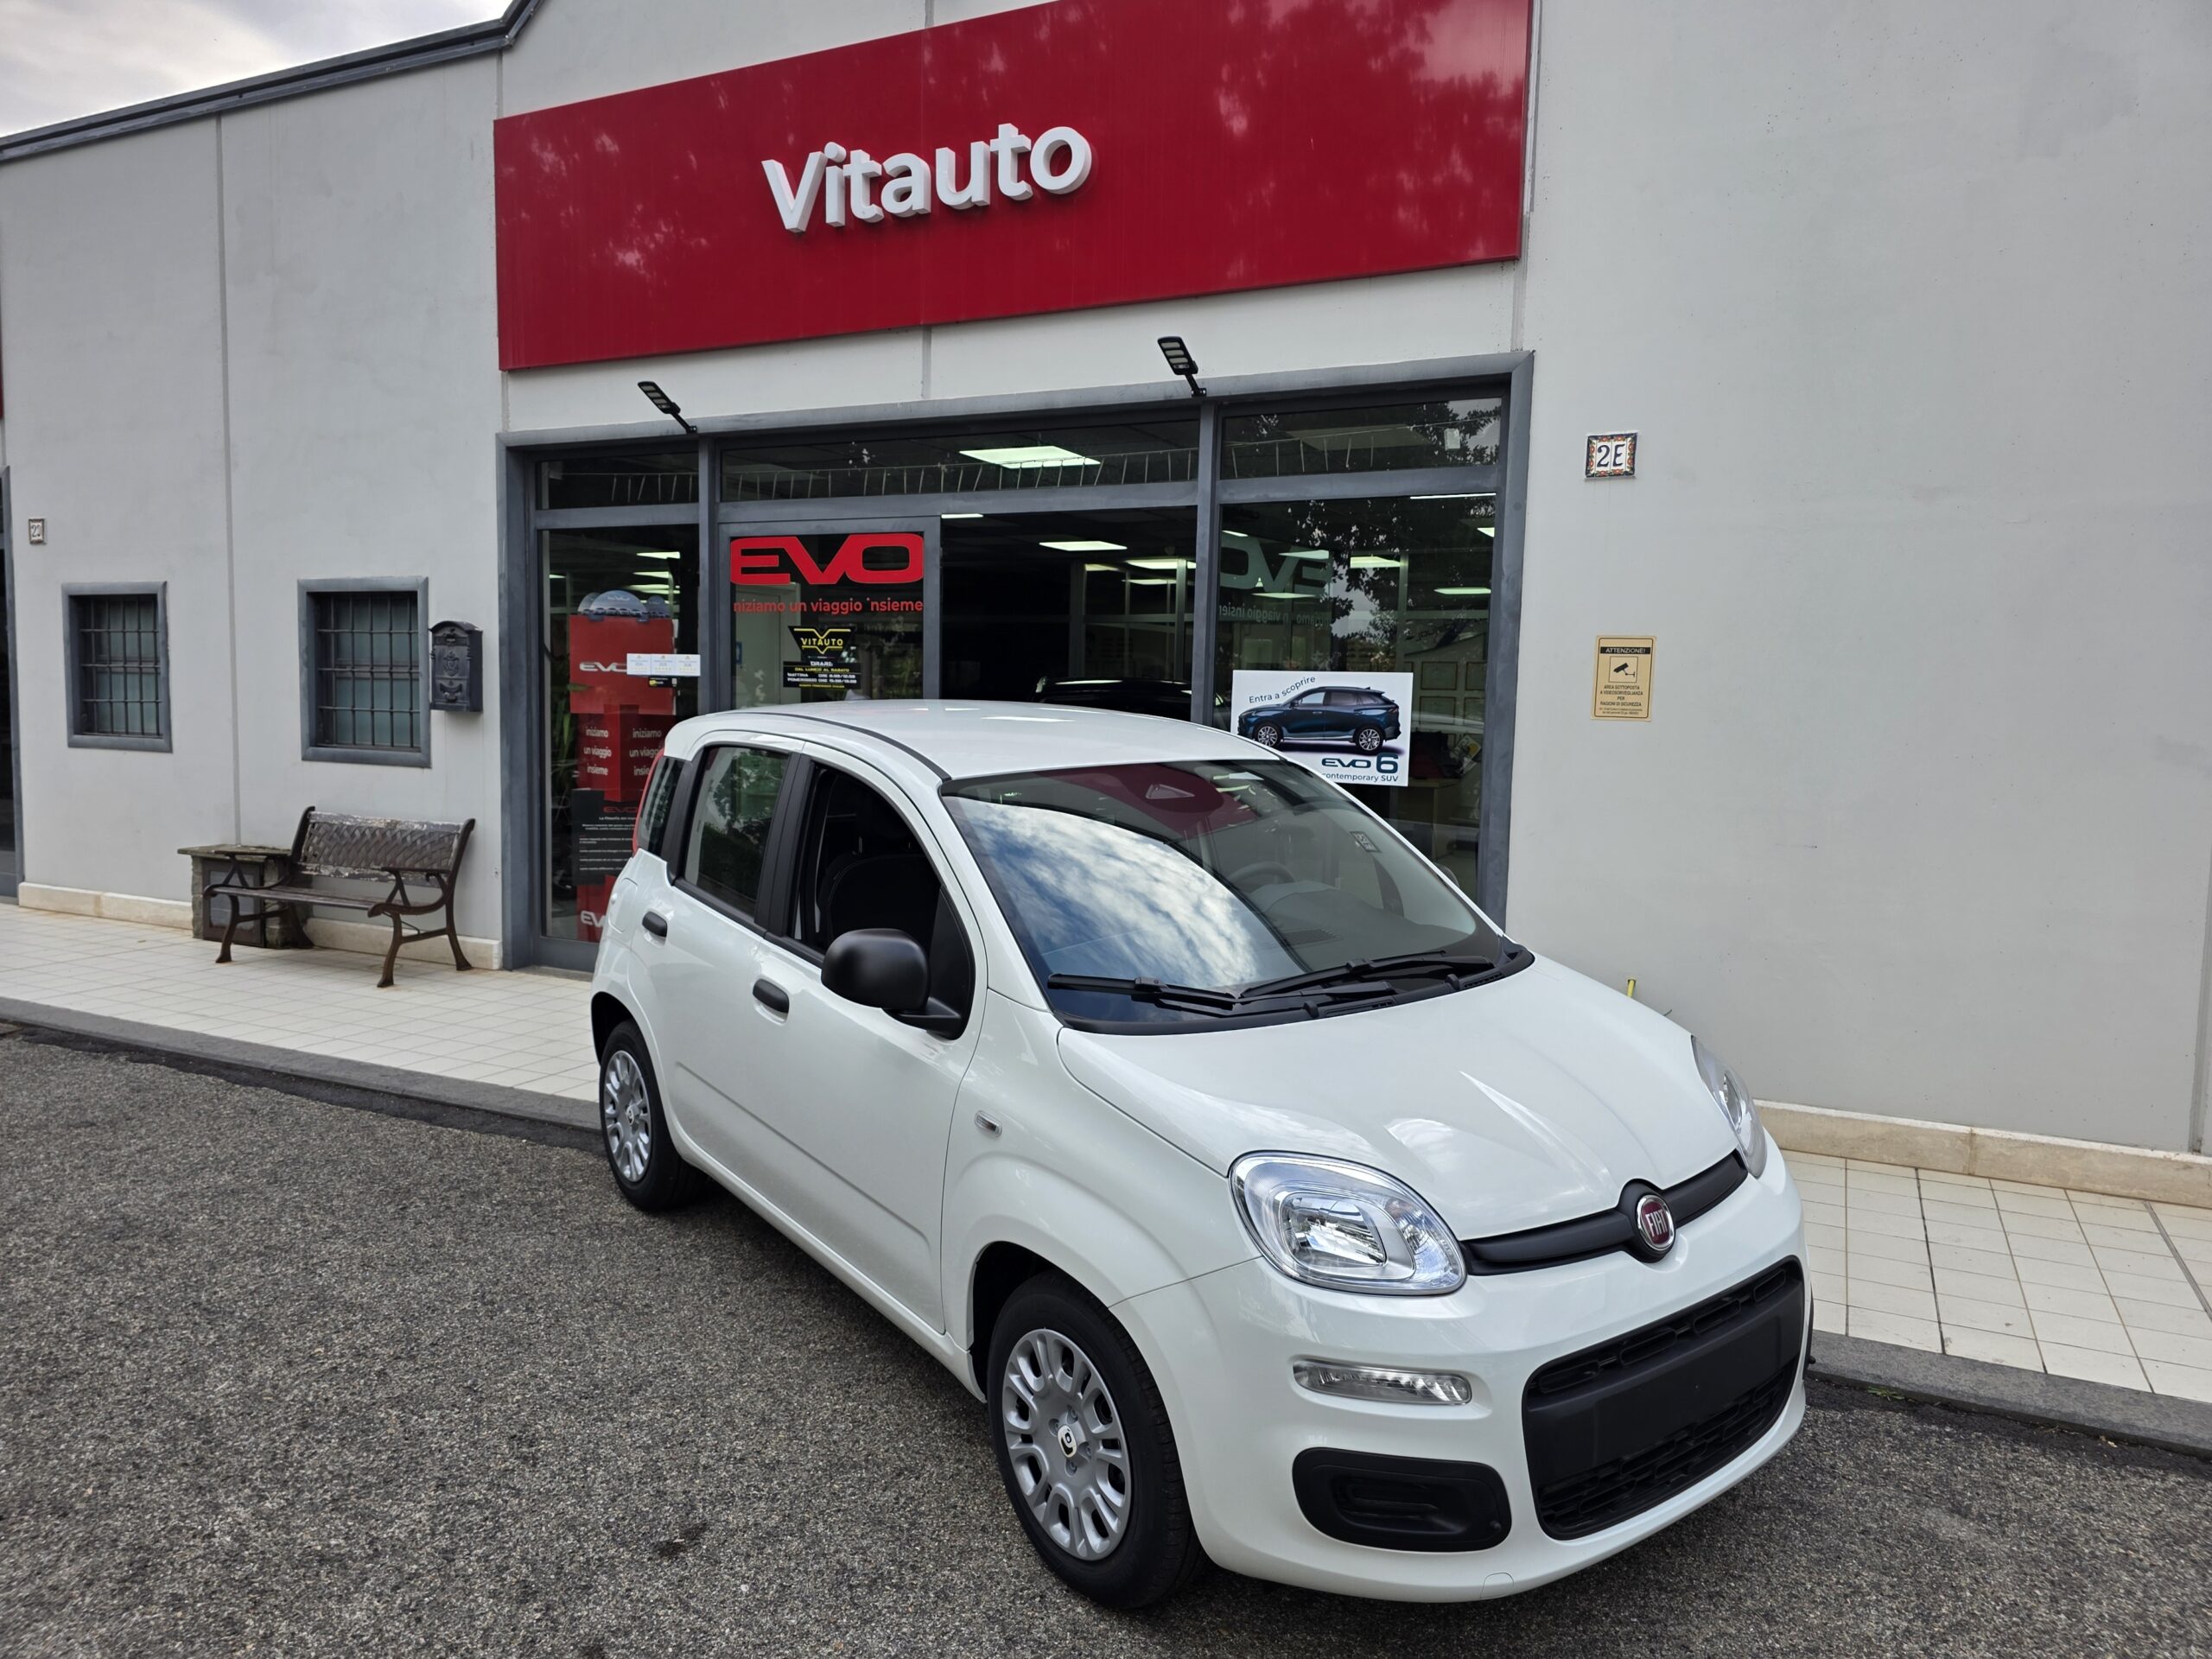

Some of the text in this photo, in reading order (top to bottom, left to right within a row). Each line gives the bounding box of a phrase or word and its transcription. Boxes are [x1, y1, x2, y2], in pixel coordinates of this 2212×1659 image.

[761, 123, 1093, 233] Vitauto
[1597, 444, 1625, 467] 2E
[730, 533, 924, 585] EVO
[789, 601, 807, 613] un
[810, 598, 862, 615] viaggio
[1249, 693, 1273, 704] Entra
[1281, 677, 1316, 696] scoprire
[586, 727, 608, 738] iniziamo
[632, 728, 662, 739] iniziamo
[592, 746, 612, 759] viaggio
[629, 748, 639, 758] un
[1321, 752, 1399, 774] EVO 6
[1644, 1209, 1669, 1237] FIAT
